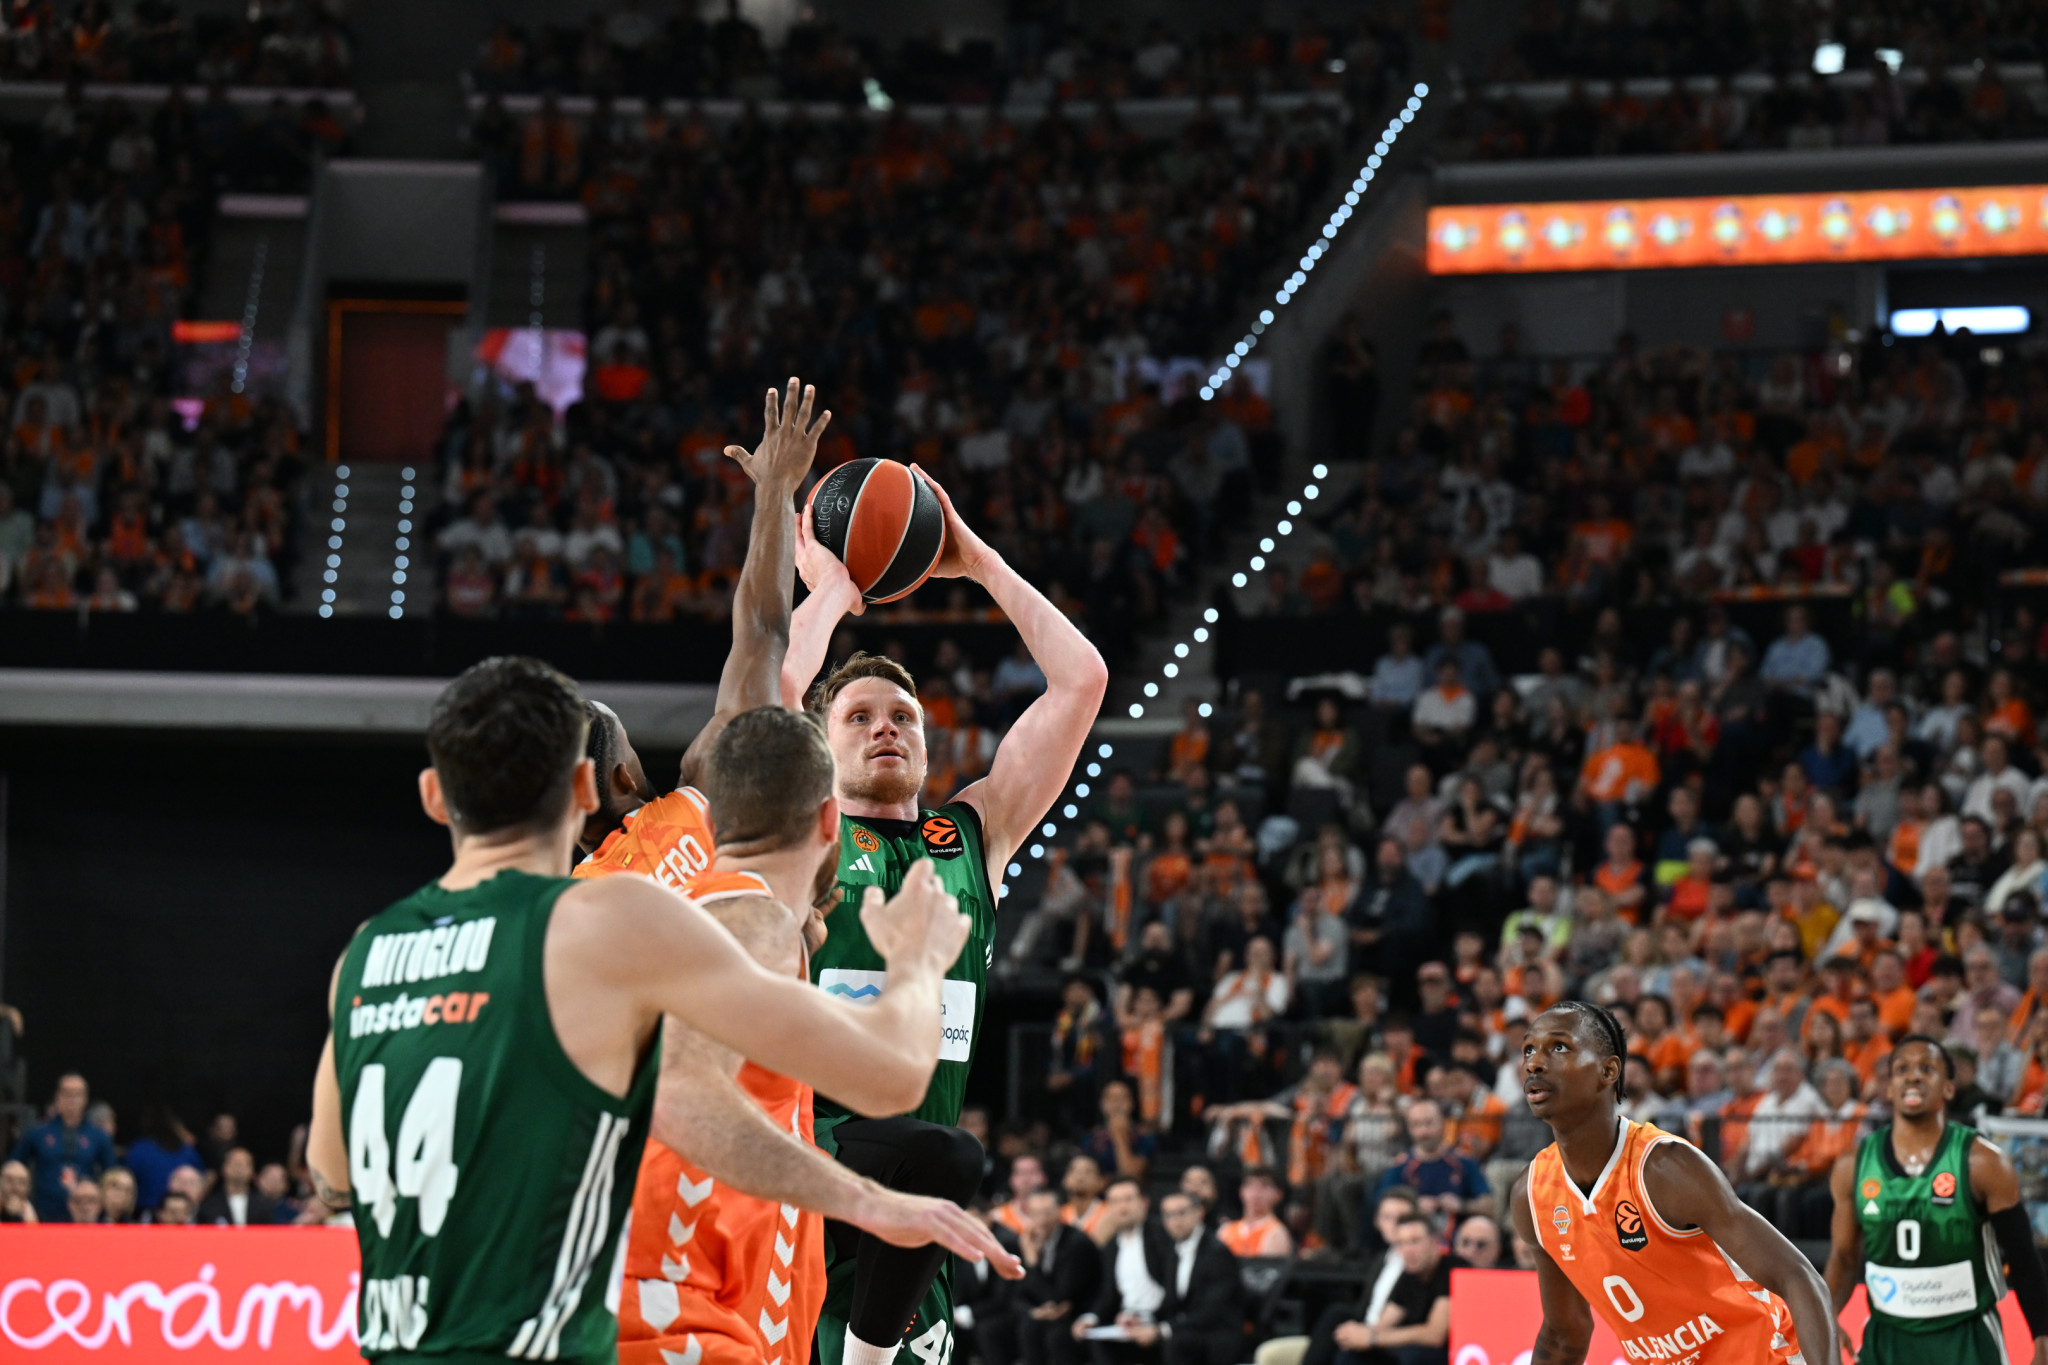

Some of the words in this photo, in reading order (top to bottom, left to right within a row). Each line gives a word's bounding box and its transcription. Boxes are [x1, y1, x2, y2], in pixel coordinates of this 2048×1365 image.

[647, 834, 709, 890] ERO
[361, 916, 497, 989] MITOGLOU
[350, 992, 490, 1040] instacar
[350, 1057, 463, 1239] 44
[1896, 1219, 1921, 1261] 0
[1603, 1275, 1645, 1323] 0
